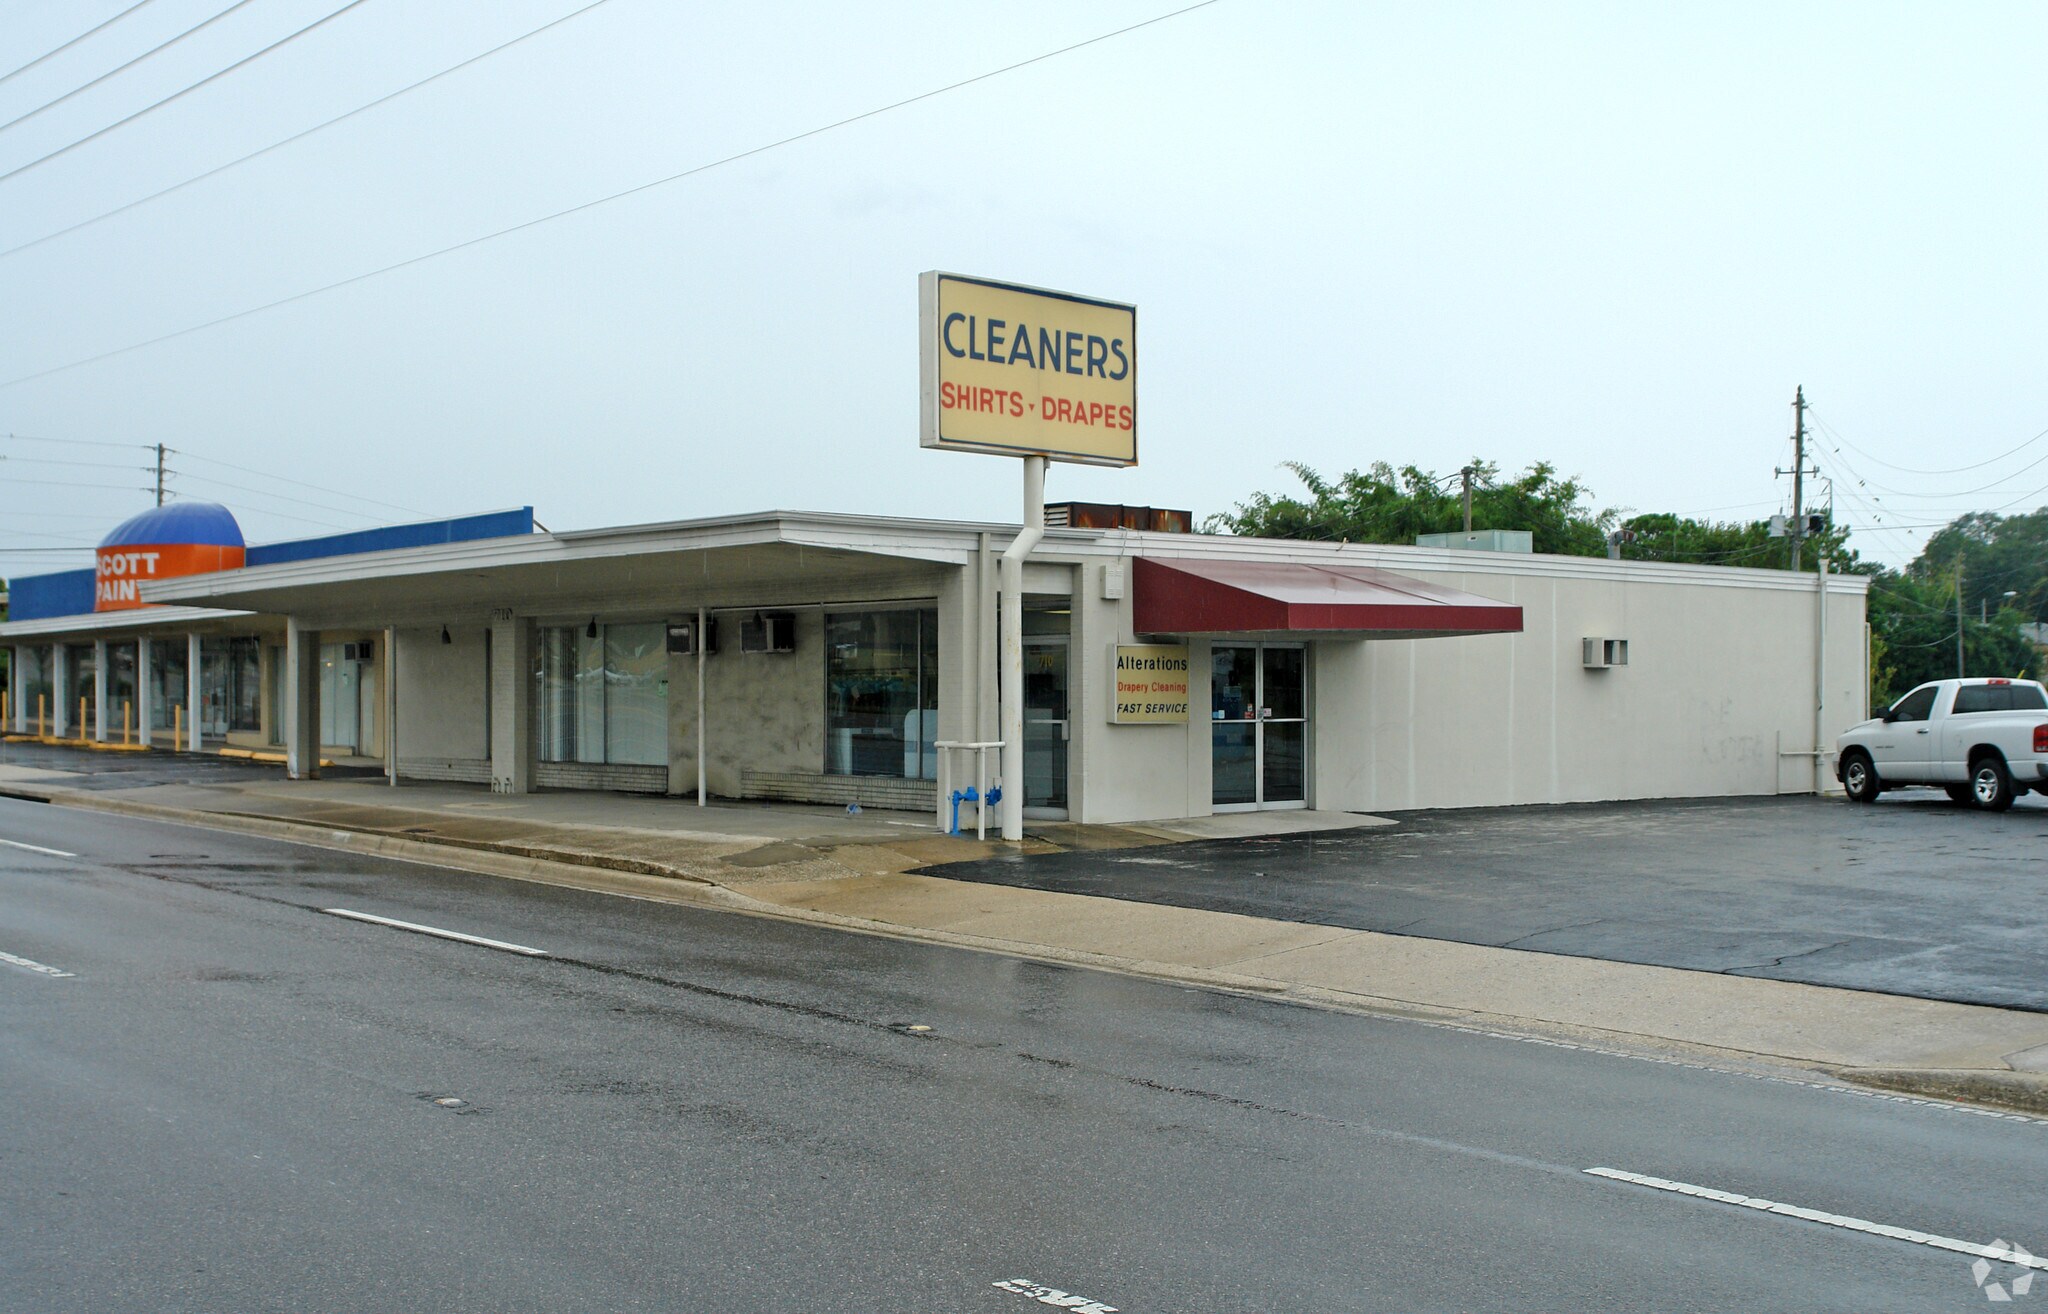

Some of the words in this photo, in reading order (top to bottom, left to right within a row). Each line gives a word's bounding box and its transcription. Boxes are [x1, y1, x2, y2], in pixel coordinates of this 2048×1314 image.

[944, 312, 1128, 380] CLEANERS
[941, 381, 1024, 417] SHIRTS
[1042, 396, 1133, 431] DRAPES
[97, 579, 145, 602] PAIN
[1117, 656, 1187, 671] Alterations
[1118, 682, 1148, 694] Drapery
[1151, 682, 1187, 694] Cleaning
[1117, 704, 1142, 713] FAST
[1145, 704, 1187, 713] SERVICE
